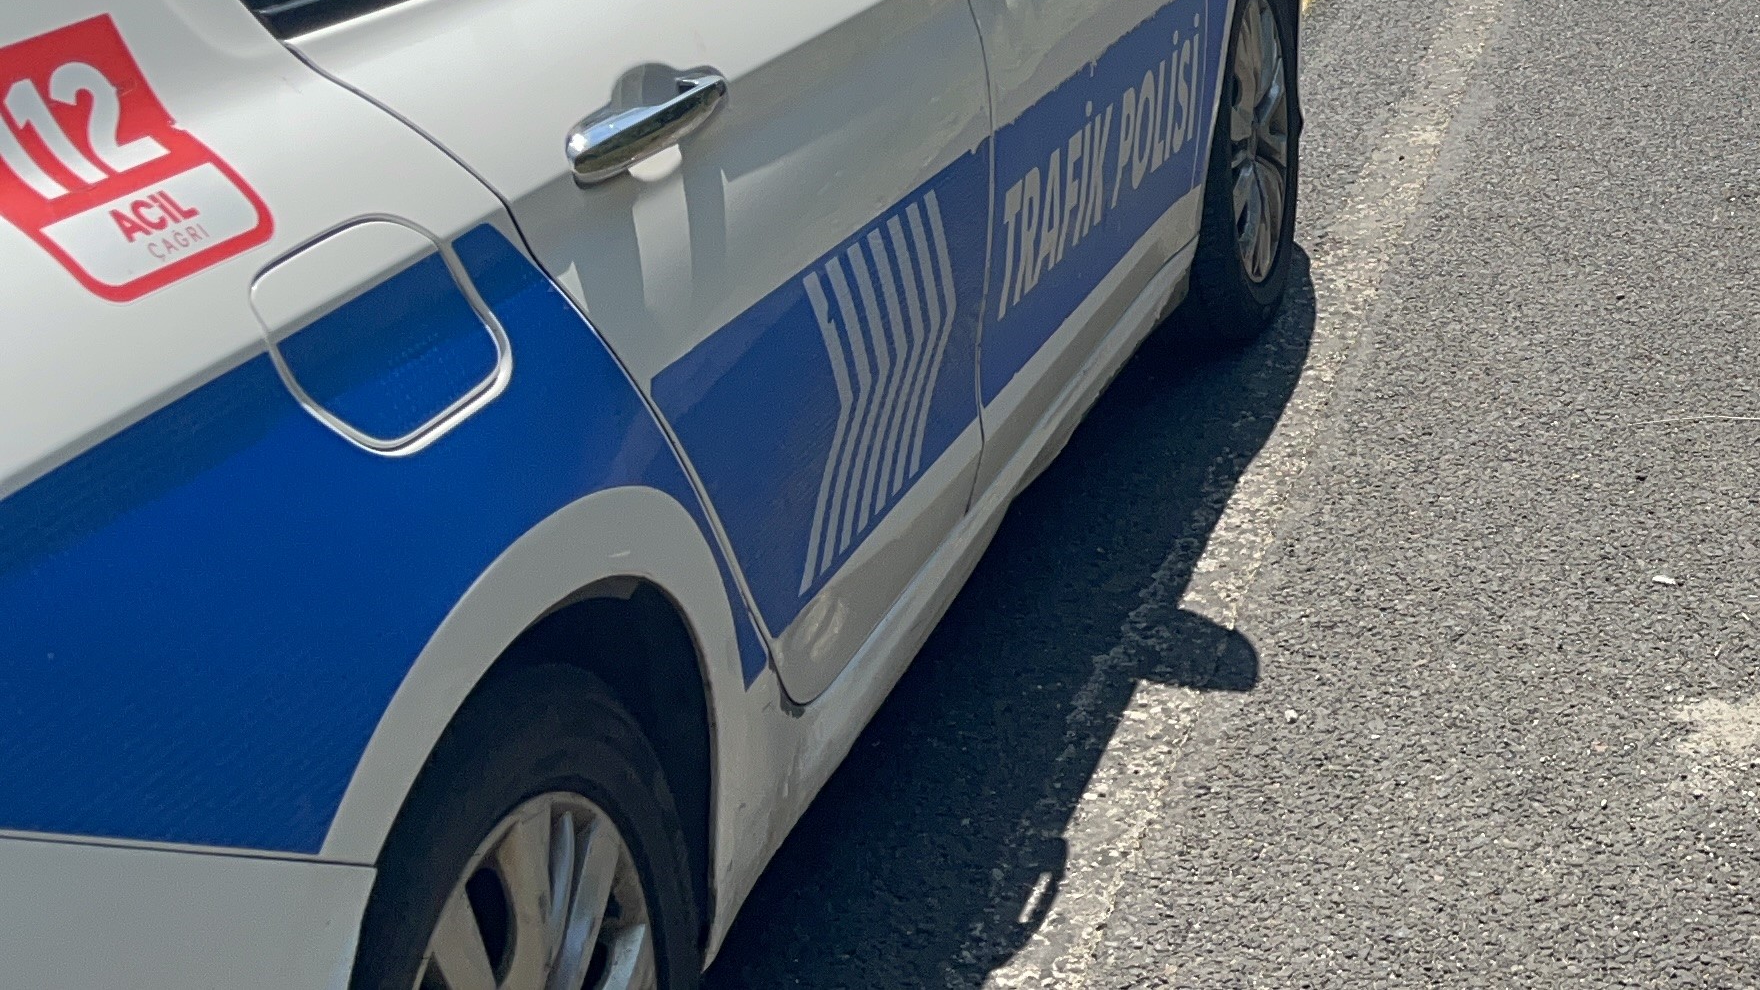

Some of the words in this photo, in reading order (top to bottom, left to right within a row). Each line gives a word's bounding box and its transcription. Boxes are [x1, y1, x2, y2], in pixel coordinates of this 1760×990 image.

[147, 223, 210, 261] ÇAĞRI
[997, 100, 1113, 322] TRAFİK
[1111, 13, 1200, 210] POLİSİ
